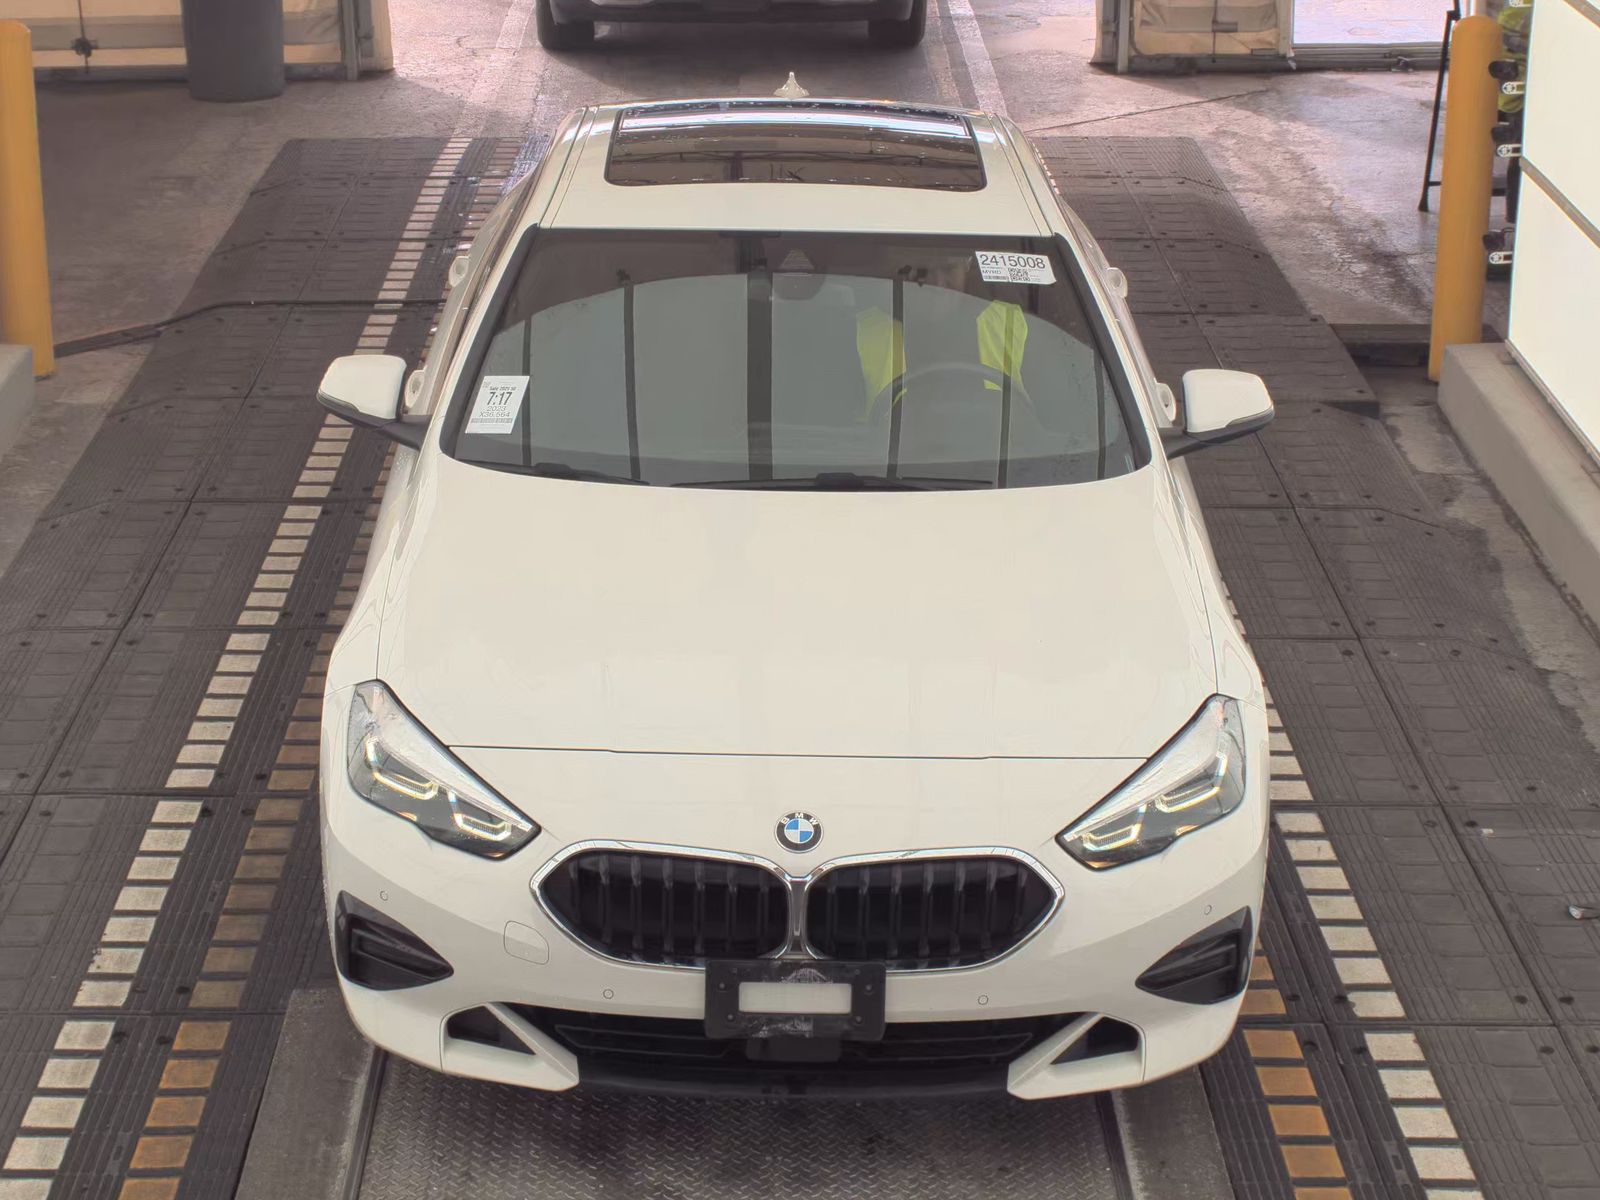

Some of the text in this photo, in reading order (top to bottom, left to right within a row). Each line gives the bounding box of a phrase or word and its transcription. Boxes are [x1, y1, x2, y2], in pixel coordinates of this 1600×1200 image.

[980, 253, 1046, 269] 2415008
[487, 392, 513, 405] 7:17
[781, 812, 819, 825] BMW
